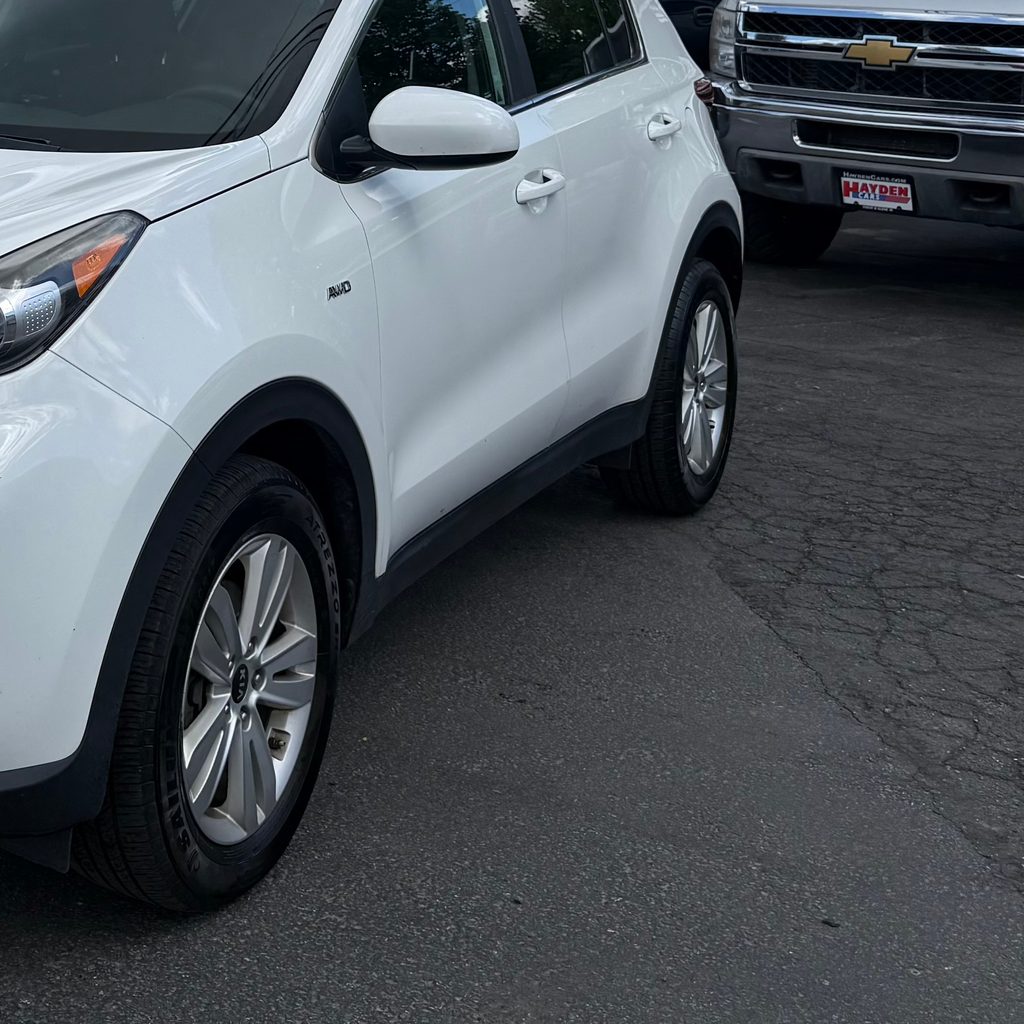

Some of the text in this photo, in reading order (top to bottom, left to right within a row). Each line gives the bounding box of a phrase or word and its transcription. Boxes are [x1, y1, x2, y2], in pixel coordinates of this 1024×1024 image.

[843, 181, 908, 197] HAYDEN
[858, 192, 880, 200] CARS
[327, 280, 352, 301] AWD
[306, 512, 340, 613] ATREZZO
